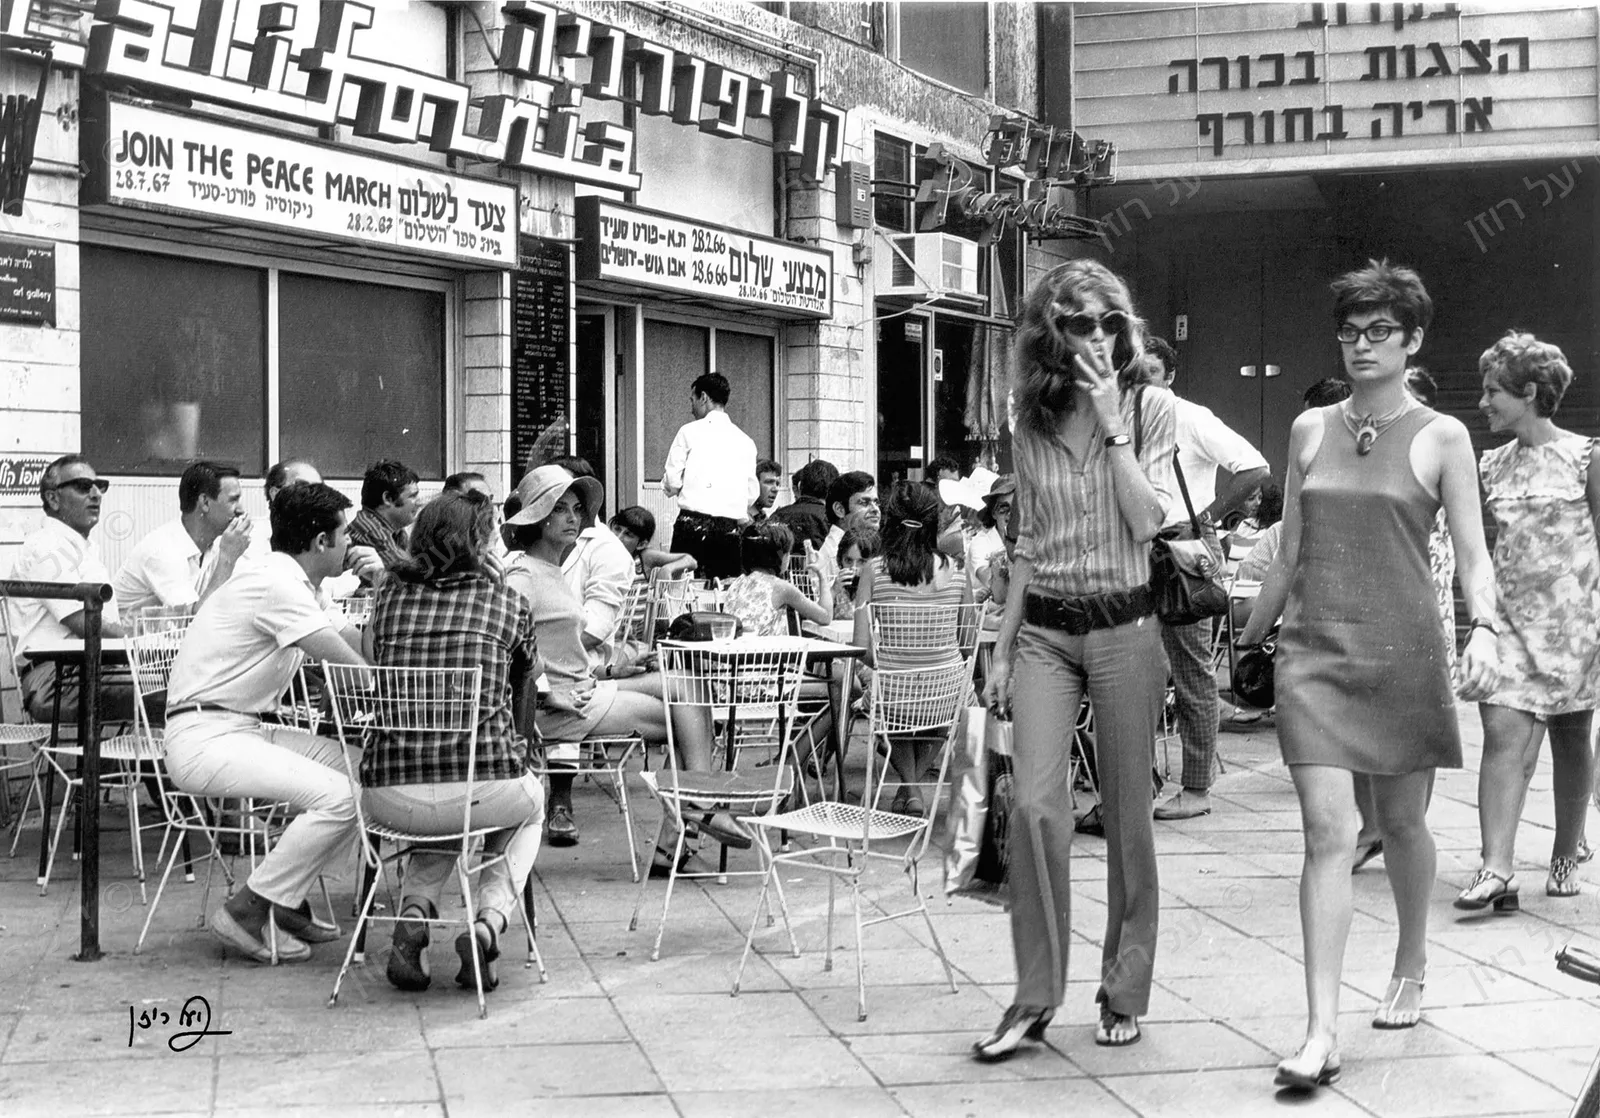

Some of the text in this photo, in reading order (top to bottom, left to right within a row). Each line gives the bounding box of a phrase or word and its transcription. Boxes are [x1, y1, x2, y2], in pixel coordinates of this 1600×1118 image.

[1168, 37, 1529, 94] הצגות בכורה
[1195, 96, 1494, 156] אריה בחורף
[115, 129, 392, 210] JOIN THE PEACE MARCH
[115, 169, 314, 220] ניקוסיה פורט-סעיד 28.7.67
[397, 178, 507, 233] צעד לשלום
[346, 211, 394, 235] 28.2.67
[599, 215, 629, 241] סעיד
[452, 229, 477, 250] ספר
[479, 235, 503, 256] בית
[691, 227, 726, 255] 28.2.66
[667, 256, 687, 278] אבו
[691, 259, 728, 287] 28.6.66
[728, 240, 827, 300] מבצעי שלום
[13, 286, 52, 303] art gallery
[738, 284, 768, 301] 28.10.66
